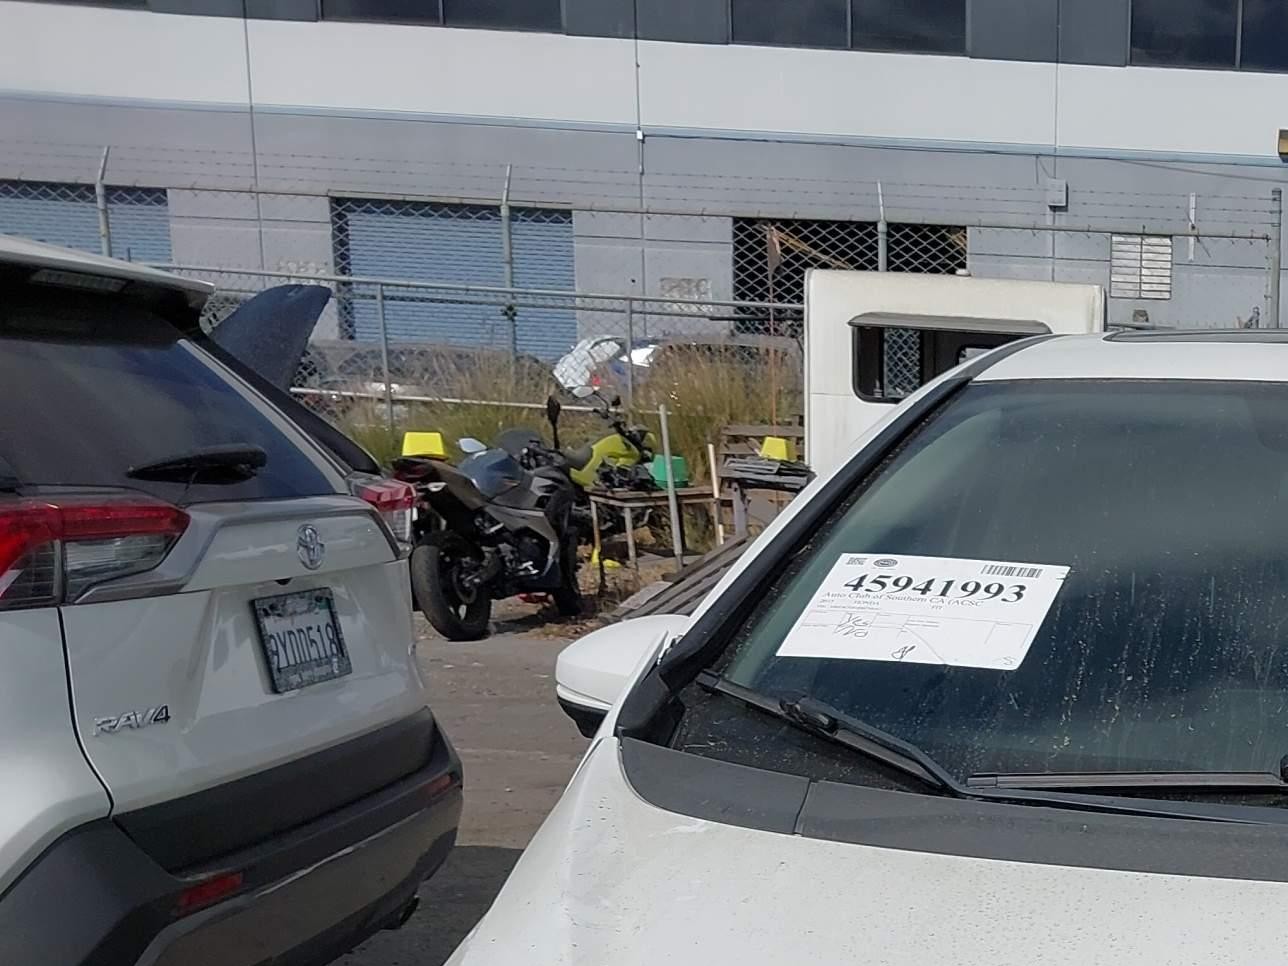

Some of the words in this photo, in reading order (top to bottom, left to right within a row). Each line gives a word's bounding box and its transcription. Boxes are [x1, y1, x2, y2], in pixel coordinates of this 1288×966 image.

[823, 591, 847, 600] Auto
[848, 592, 872, 600] Club
[885, 593, 928, 602] Southern
[929, 596, 945, 605] CA
[843, 573, 1027, 603] 45941993
[93, 703, 172, 736] RAV4
